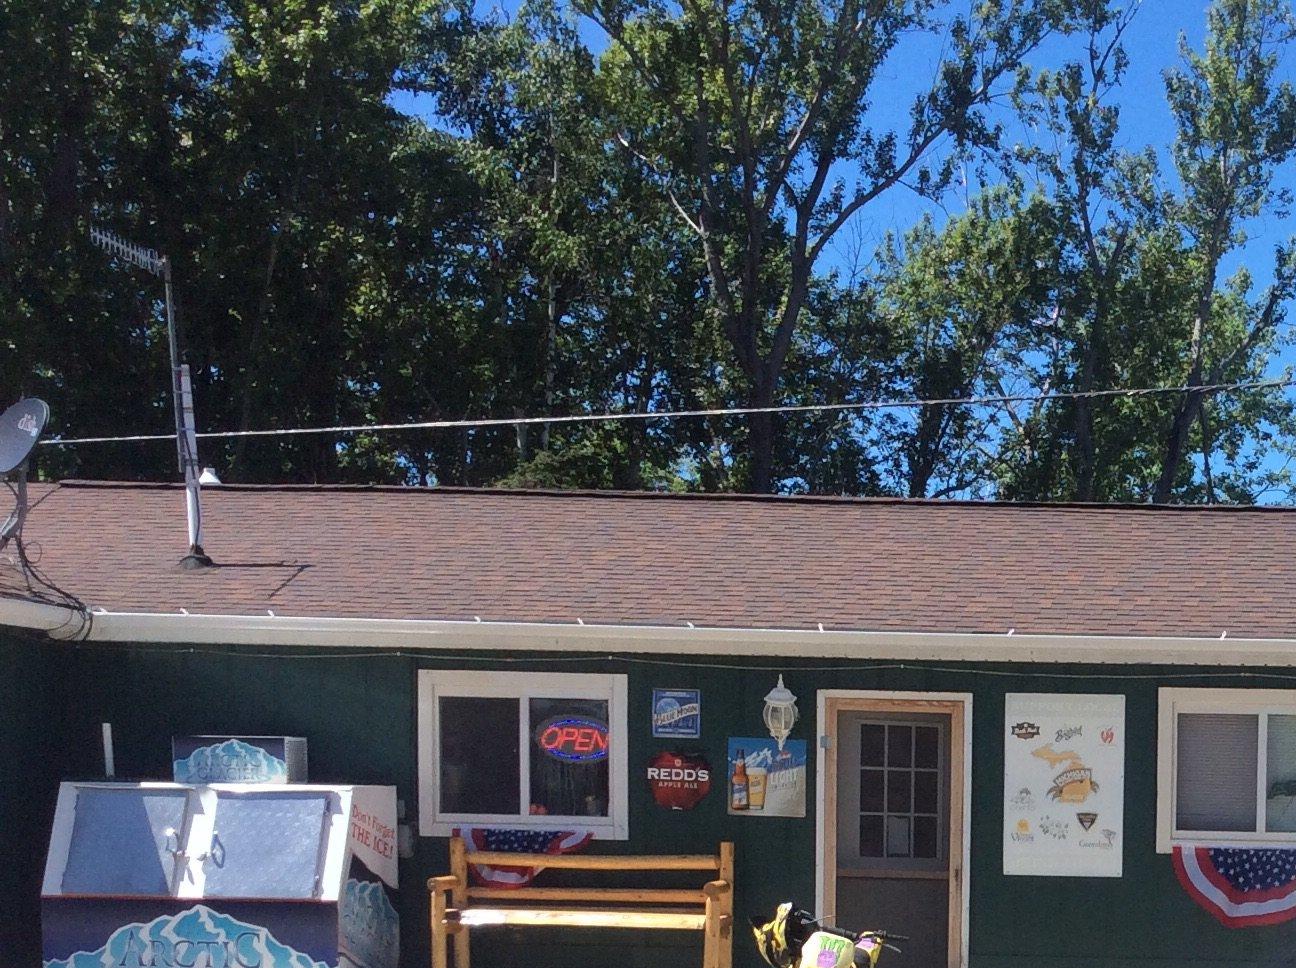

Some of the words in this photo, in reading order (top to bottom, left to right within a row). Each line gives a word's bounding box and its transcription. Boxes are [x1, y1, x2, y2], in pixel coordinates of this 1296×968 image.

[540, 727, 608, 751] OPEN
[352, 821, 371, 847] THE
[372, 836, 394, 860] ICE!
